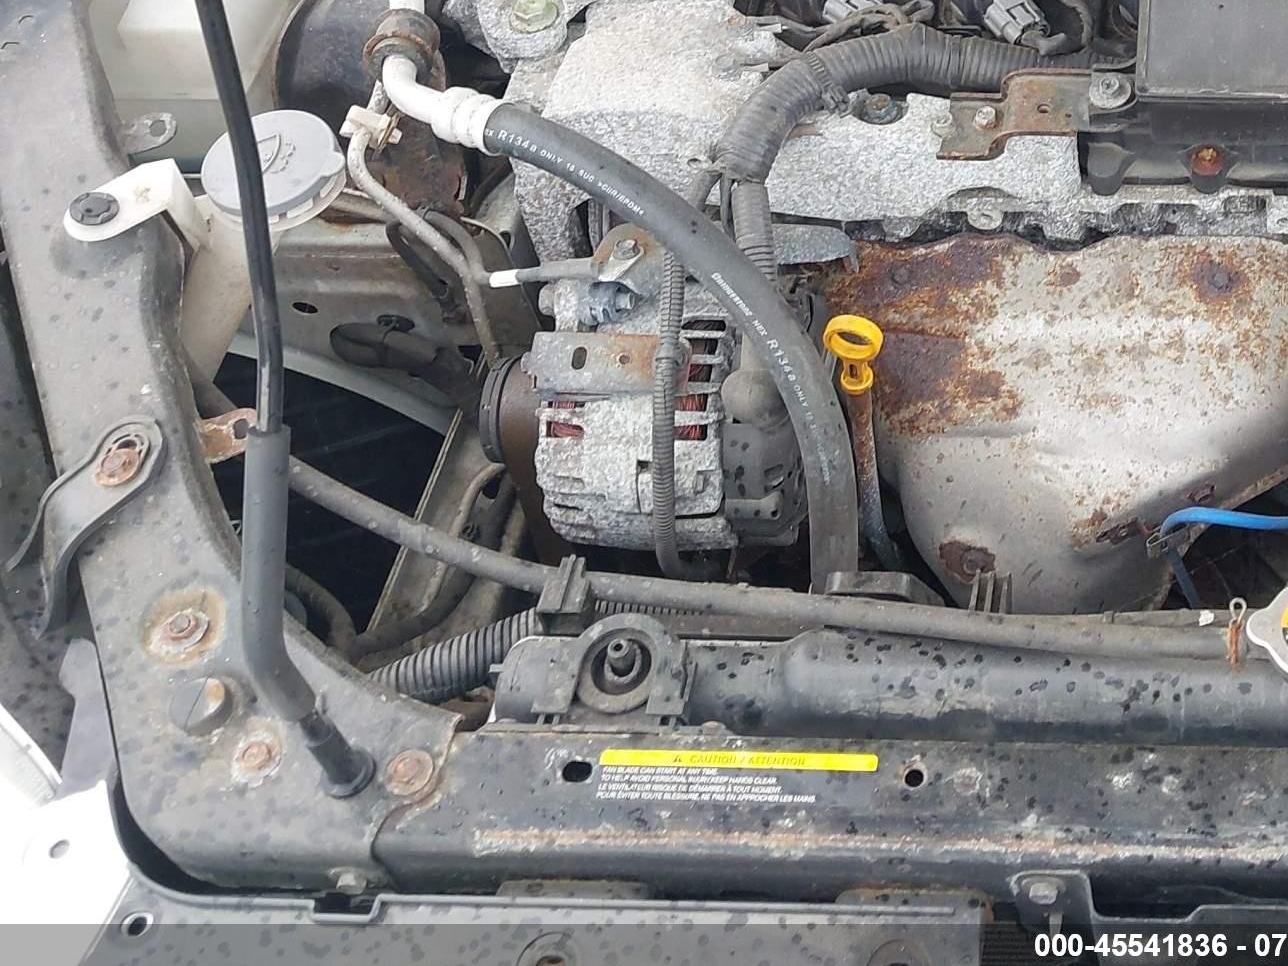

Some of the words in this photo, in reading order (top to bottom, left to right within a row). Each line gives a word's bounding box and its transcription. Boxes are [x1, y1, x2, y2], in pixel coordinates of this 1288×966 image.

[540, 149, 563, 164] ONLY
[690, 754, 736, 764] CAUTION
[748, 756, 806, 766] ATTENTION
[602, 766, 616, 774] FAN
[601, 774, 611, 782] TO
[629, 774, 650, 782] AVOID
[651, 775, 687, 784] PERSONAL
[728, 776, 754, 784] HANDS
[598, 783, 608, 791] LE
[608, 784, 651, 792] VENTILATEUR
[732, 785, 752, 793] TOUT
[596, 791, 616, 799] POUR
[640, 792, 663, 800] TOUTE
[700, 793, 712, 801] NE
[711, 793, 726, 802] PAS
[726, 794, 738, 802] EN
[736, 794, 780, 802] APPROCHER
[780, 794, 794, 802] LES
